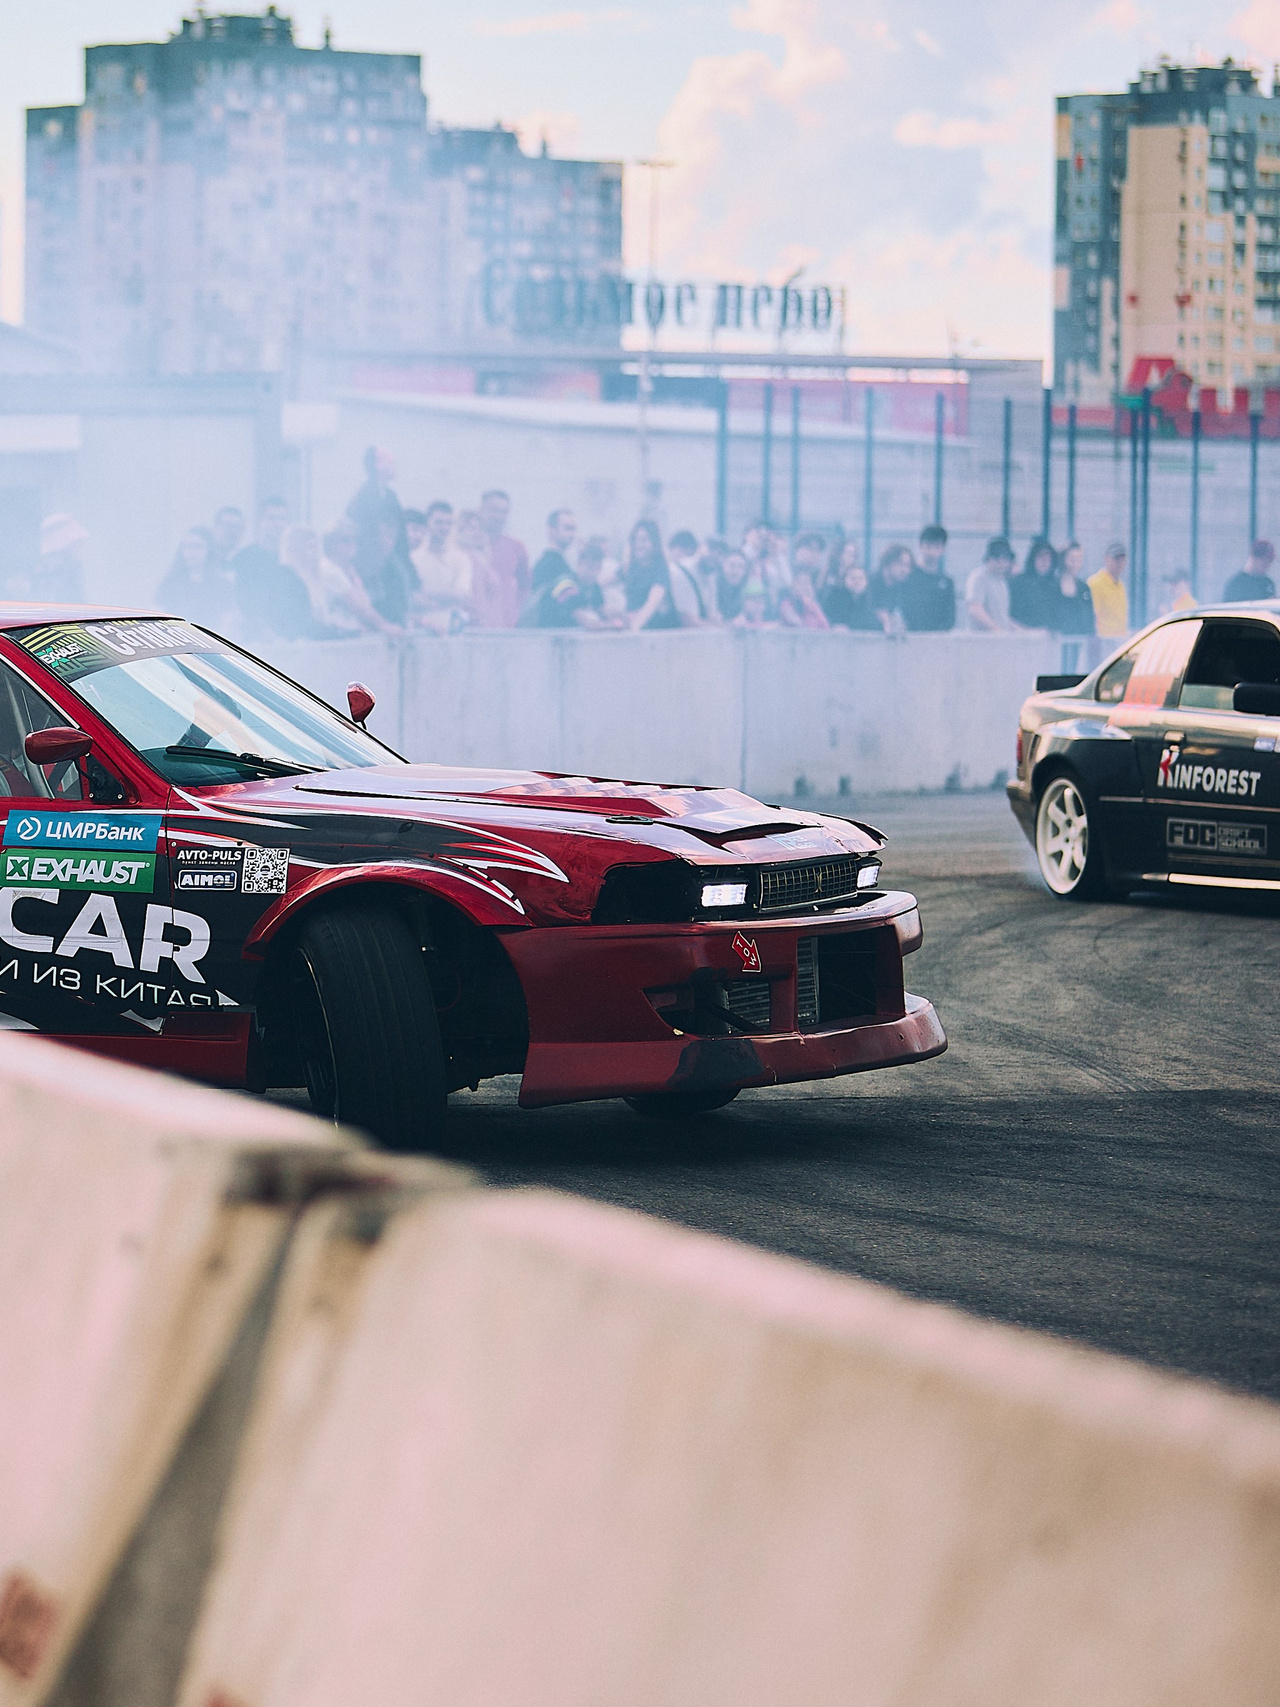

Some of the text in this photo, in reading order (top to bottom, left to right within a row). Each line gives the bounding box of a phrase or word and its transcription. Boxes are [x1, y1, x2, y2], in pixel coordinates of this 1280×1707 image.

[45, 821, 146, 841] ЦМРБанк
[177, 850, 242, 861] AVTO-PULS
[31, 857, 147, 885] EXHAUST
[181, 874, 234, 887] AIMOL
[736, 938, 757, 967] TOW
[32, 962, 82, 991] ИЗ
